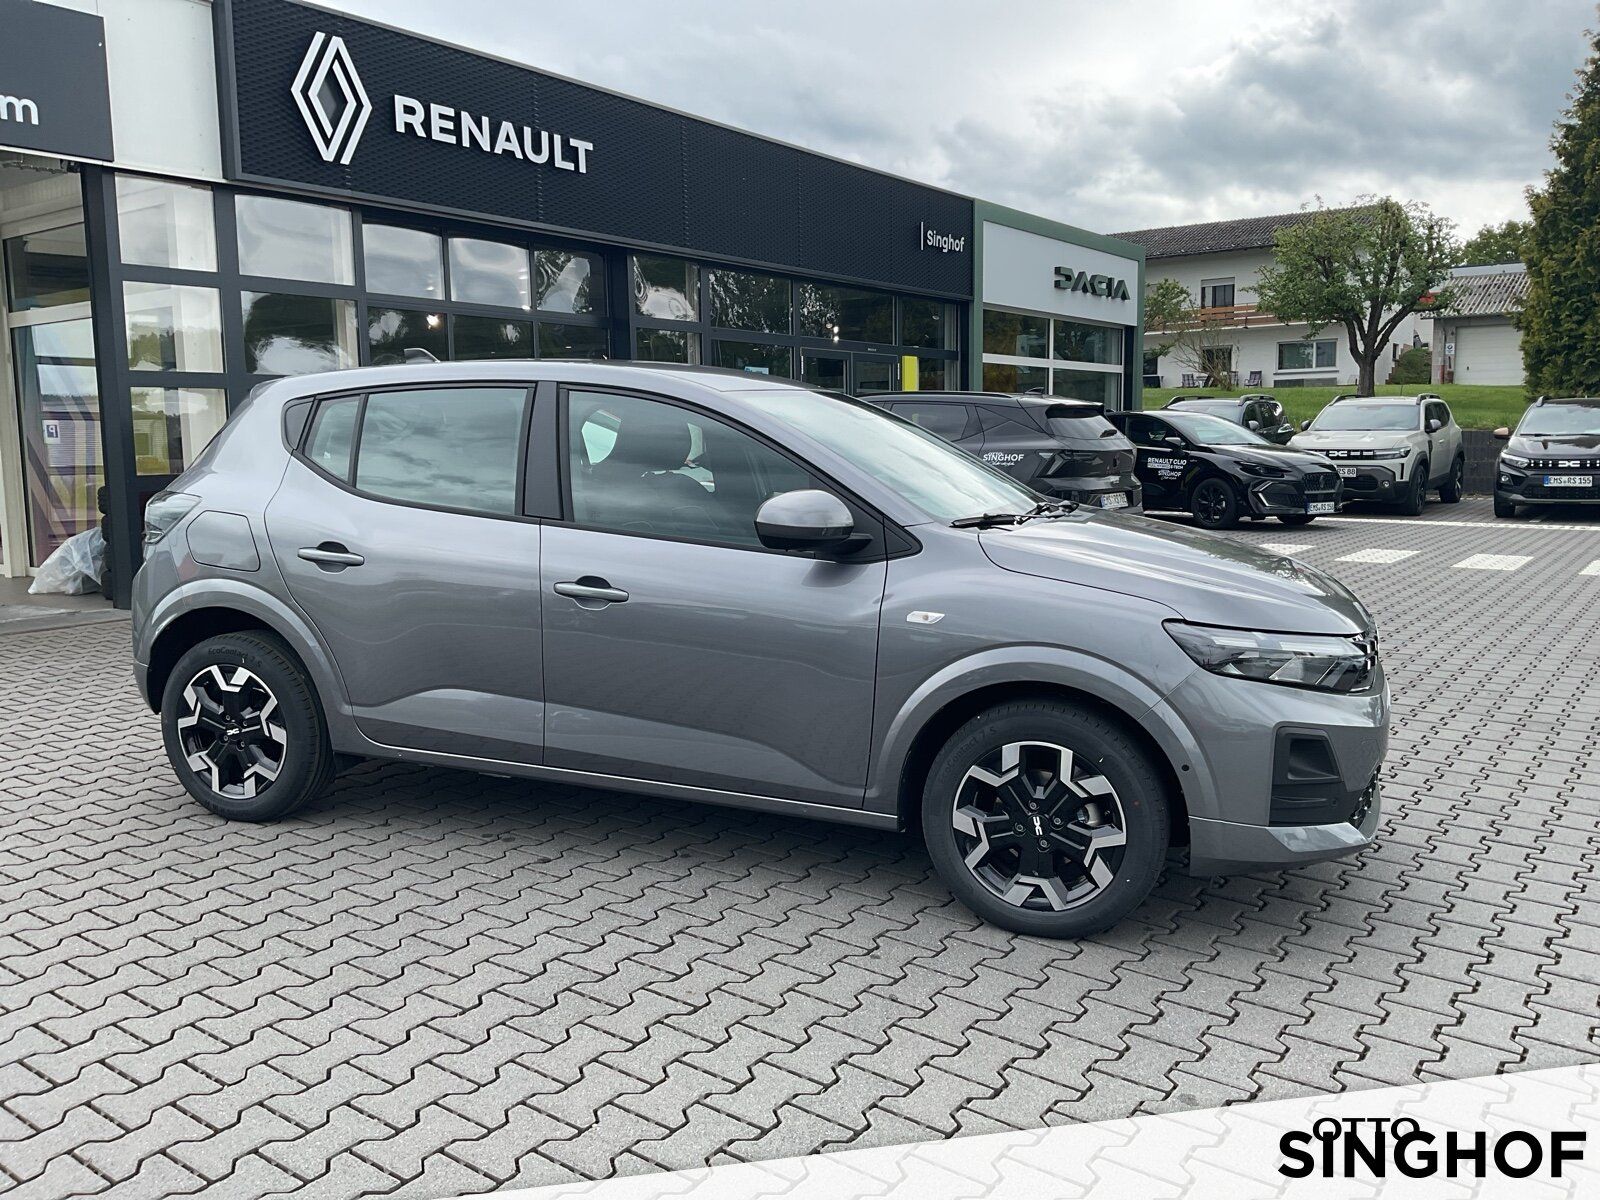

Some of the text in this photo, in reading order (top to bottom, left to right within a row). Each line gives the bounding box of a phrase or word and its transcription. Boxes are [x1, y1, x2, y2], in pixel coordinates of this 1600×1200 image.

[394, 94, 594, 174] RENAULT
[926, 230, 965, 253] Singhof
[1054, 266, 1131, 300] DACIA
[982, 453, 1025, 462] SINGHOF
[1147, 457, 1173, 465] RENAULT
[1549, 477, 1592, 485] EMS RS 155
